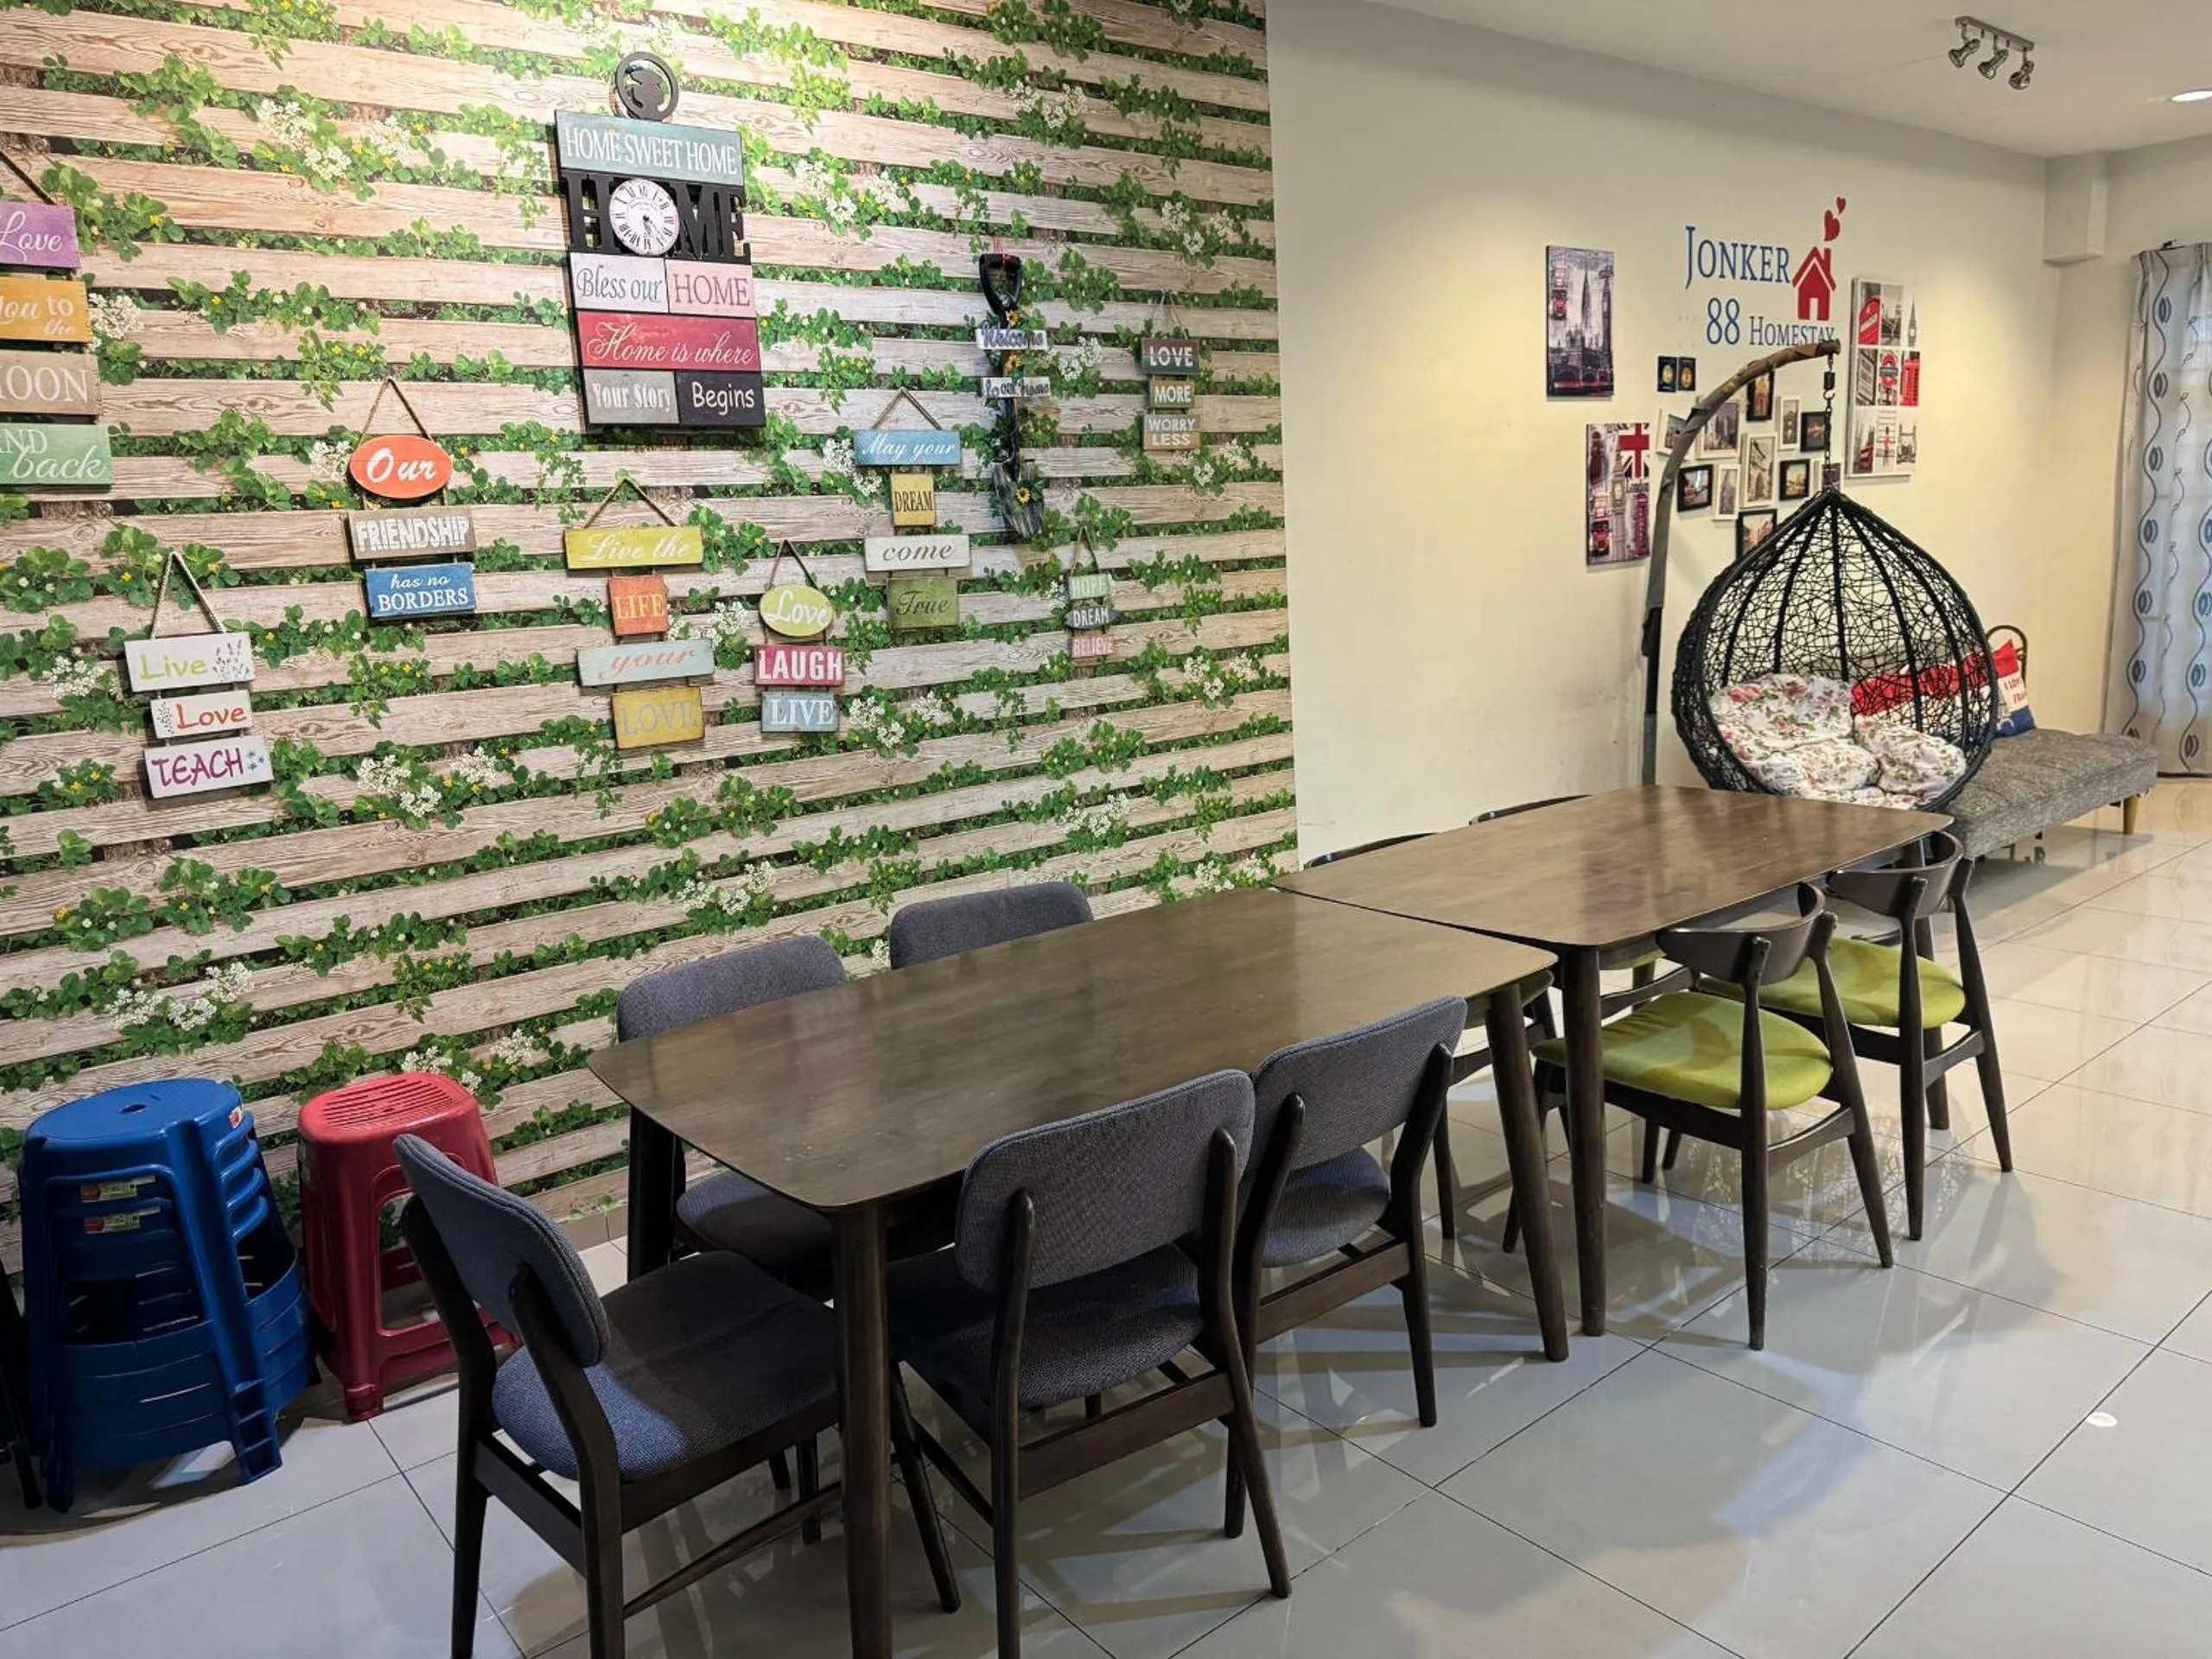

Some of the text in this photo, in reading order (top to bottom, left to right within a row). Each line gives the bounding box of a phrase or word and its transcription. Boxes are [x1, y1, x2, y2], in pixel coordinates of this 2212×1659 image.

[565, 127, 738, 174] HOME SWEET HOME
[0, 210, 63, 262] Love
[1685, 226, 1790, 289] JONKER
[576, 264, 663, 302] Bless our
[673, 274, 750, 306] HOME
[47, 295, 74, 316] to
[1707, 297, 1740, 345] 88
[587, 321, 753, 364] Home is where
[1149, 346, 1193, 367] LOVE
[0, 365, 91, 403] OON
[592, 383, 671, 411] Your Story
[691, 381, 754, 415] Begins
[1154, 385, 1192, 404] MORE
[1149, 417, 1195, 431] WORRY
[0, 428, 48, 454] ND
[862, 432, 956, 462] May your
[1152, 433, 1191, 446] LESS
[8, 445, 107, 479] back
[366, 447, 436, 483] Our
[894, 490, 933, 512] DREAM
[355, 515, 470, 551] FRIENDSHIP
[582, 532, 690, 561] Live the
[882, 543, 954, 562] come
[391, 573, 450, 590] has no
[378, 588, 468, 612] BORDERS
[614, 594, 665, 620] LIFE
[766, 589, 828, 626] Love
[896, 590, 950, 616] True
[1072, 607, 1109, 627] DREAM
[139, 653, 207, 681] Live
[598, 650, 695, 680] your
[759, 650, 842, 681] LAUGH
[176, 703, 247, 730] Love
[622, 701, 697, 735] LOVE
[770, 698, 835, 726] LIVE
[151, 747, 244, 786] TEACH
